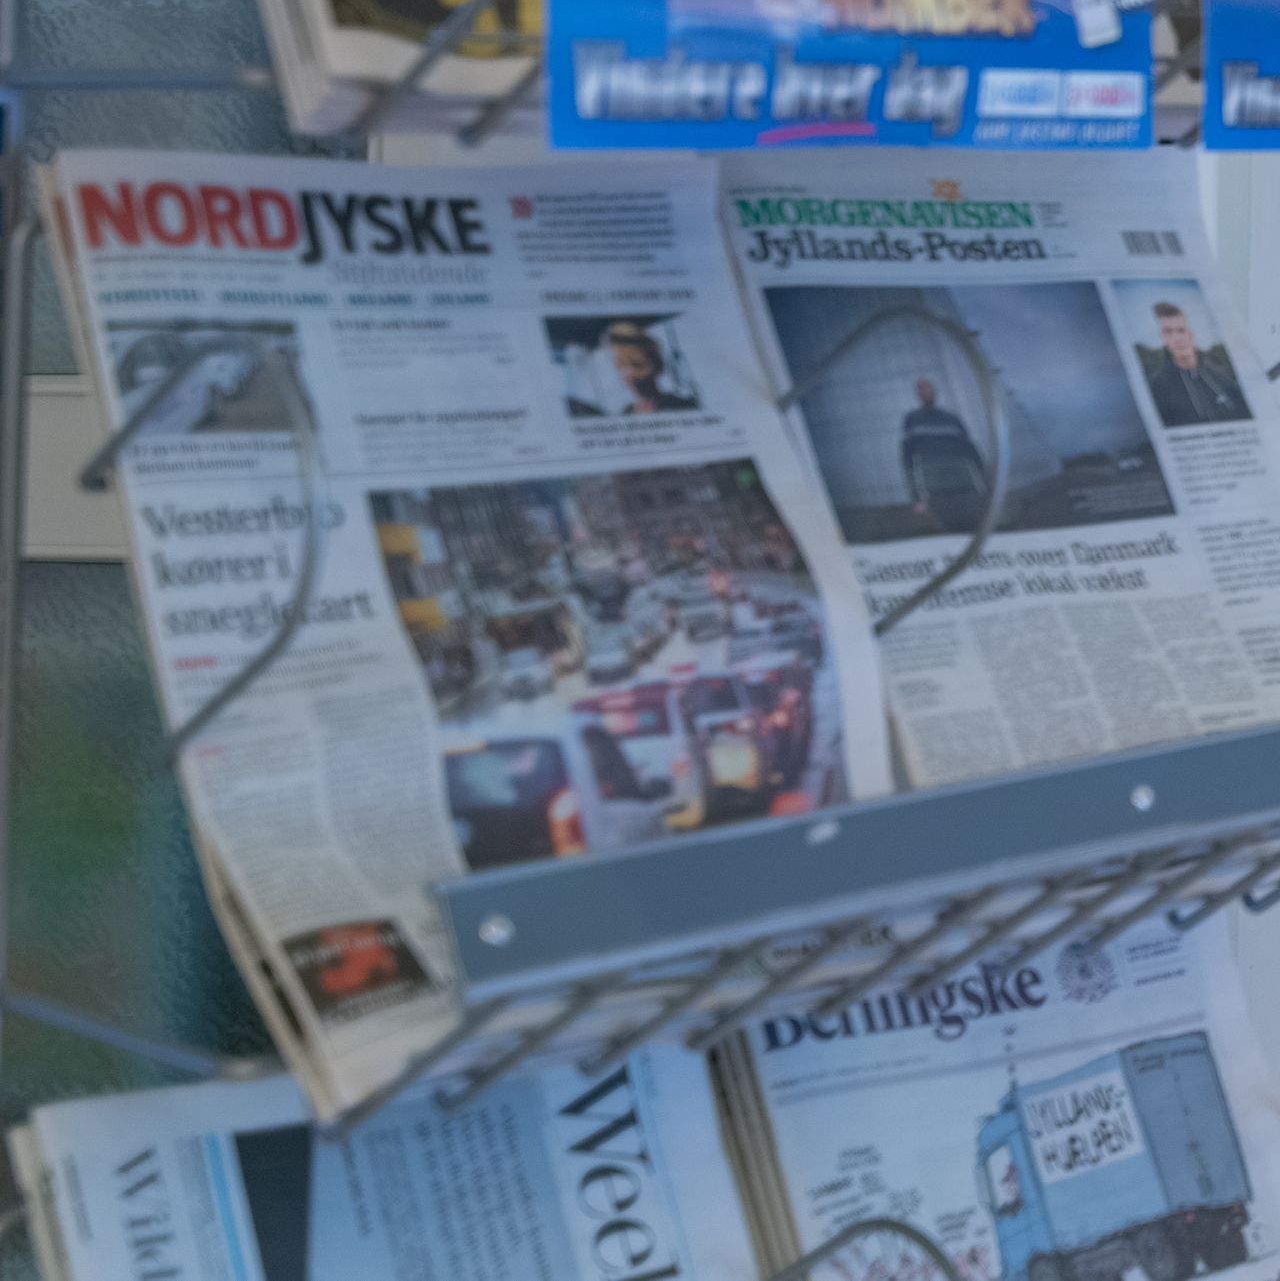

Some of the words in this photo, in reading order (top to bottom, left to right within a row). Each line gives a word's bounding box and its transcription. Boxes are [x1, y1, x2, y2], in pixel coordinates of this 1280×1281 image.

[79, 183, 491, 264] NORDJYSKE
[735, 197, 1035, 228] MORGENAVISEN
[747, 229, 1048, 268] Jyllands-Posten
